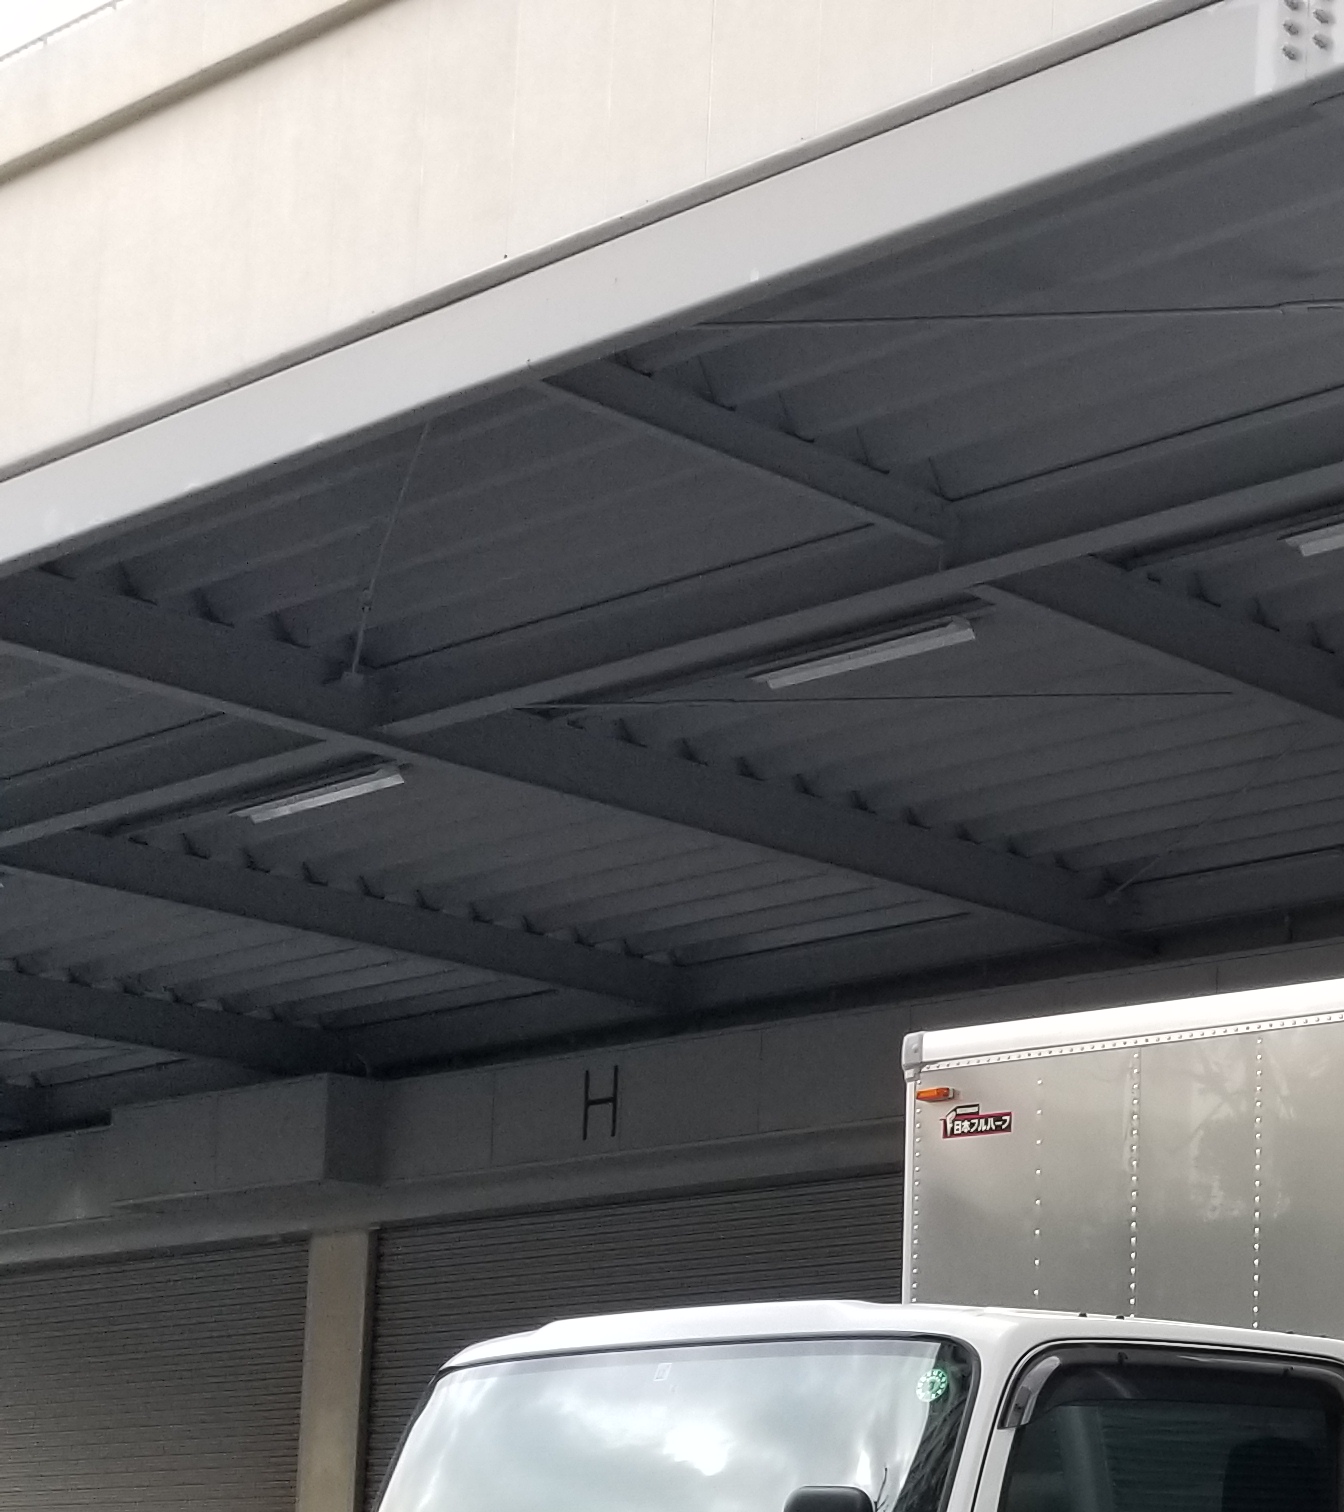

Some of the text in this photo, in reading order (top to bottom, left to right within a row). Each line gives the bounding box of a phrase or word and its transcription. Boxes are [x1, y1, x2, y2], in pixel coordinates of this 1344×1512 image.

[583, 1065, 619, 1141] H
[953, 1116, 1011, 1135] 日本フルハーフ
